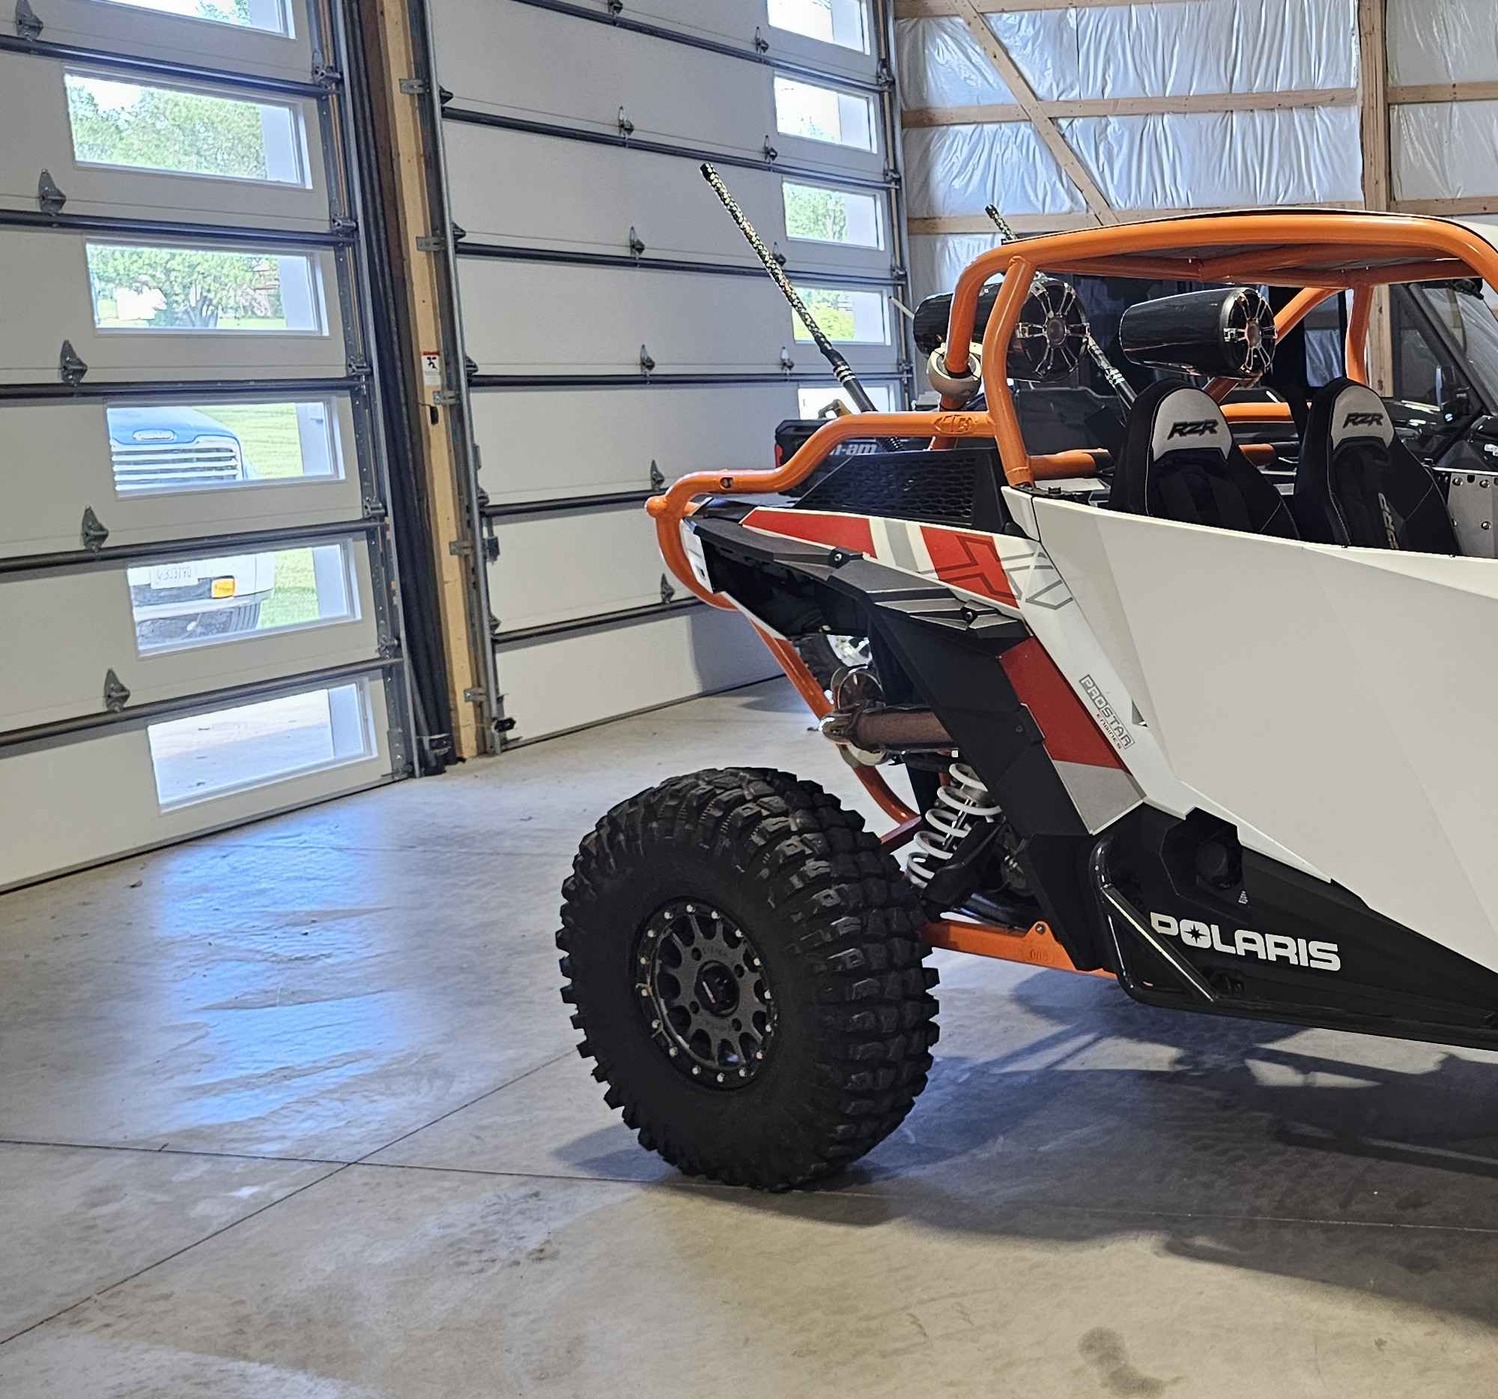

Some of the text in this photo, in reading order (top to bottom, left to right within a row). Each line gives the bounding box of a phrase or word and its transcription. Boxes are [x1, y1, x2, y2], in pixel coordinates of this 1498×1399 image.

[1167, 420, 1220, 441] RZR
[1342, 412, 1385, 429] RZR
[828, 442, 877, 455] n-am
[1079, 674, 1135, 750] PROSTAR
[1149, 912, 1342, 972] POLARIS
